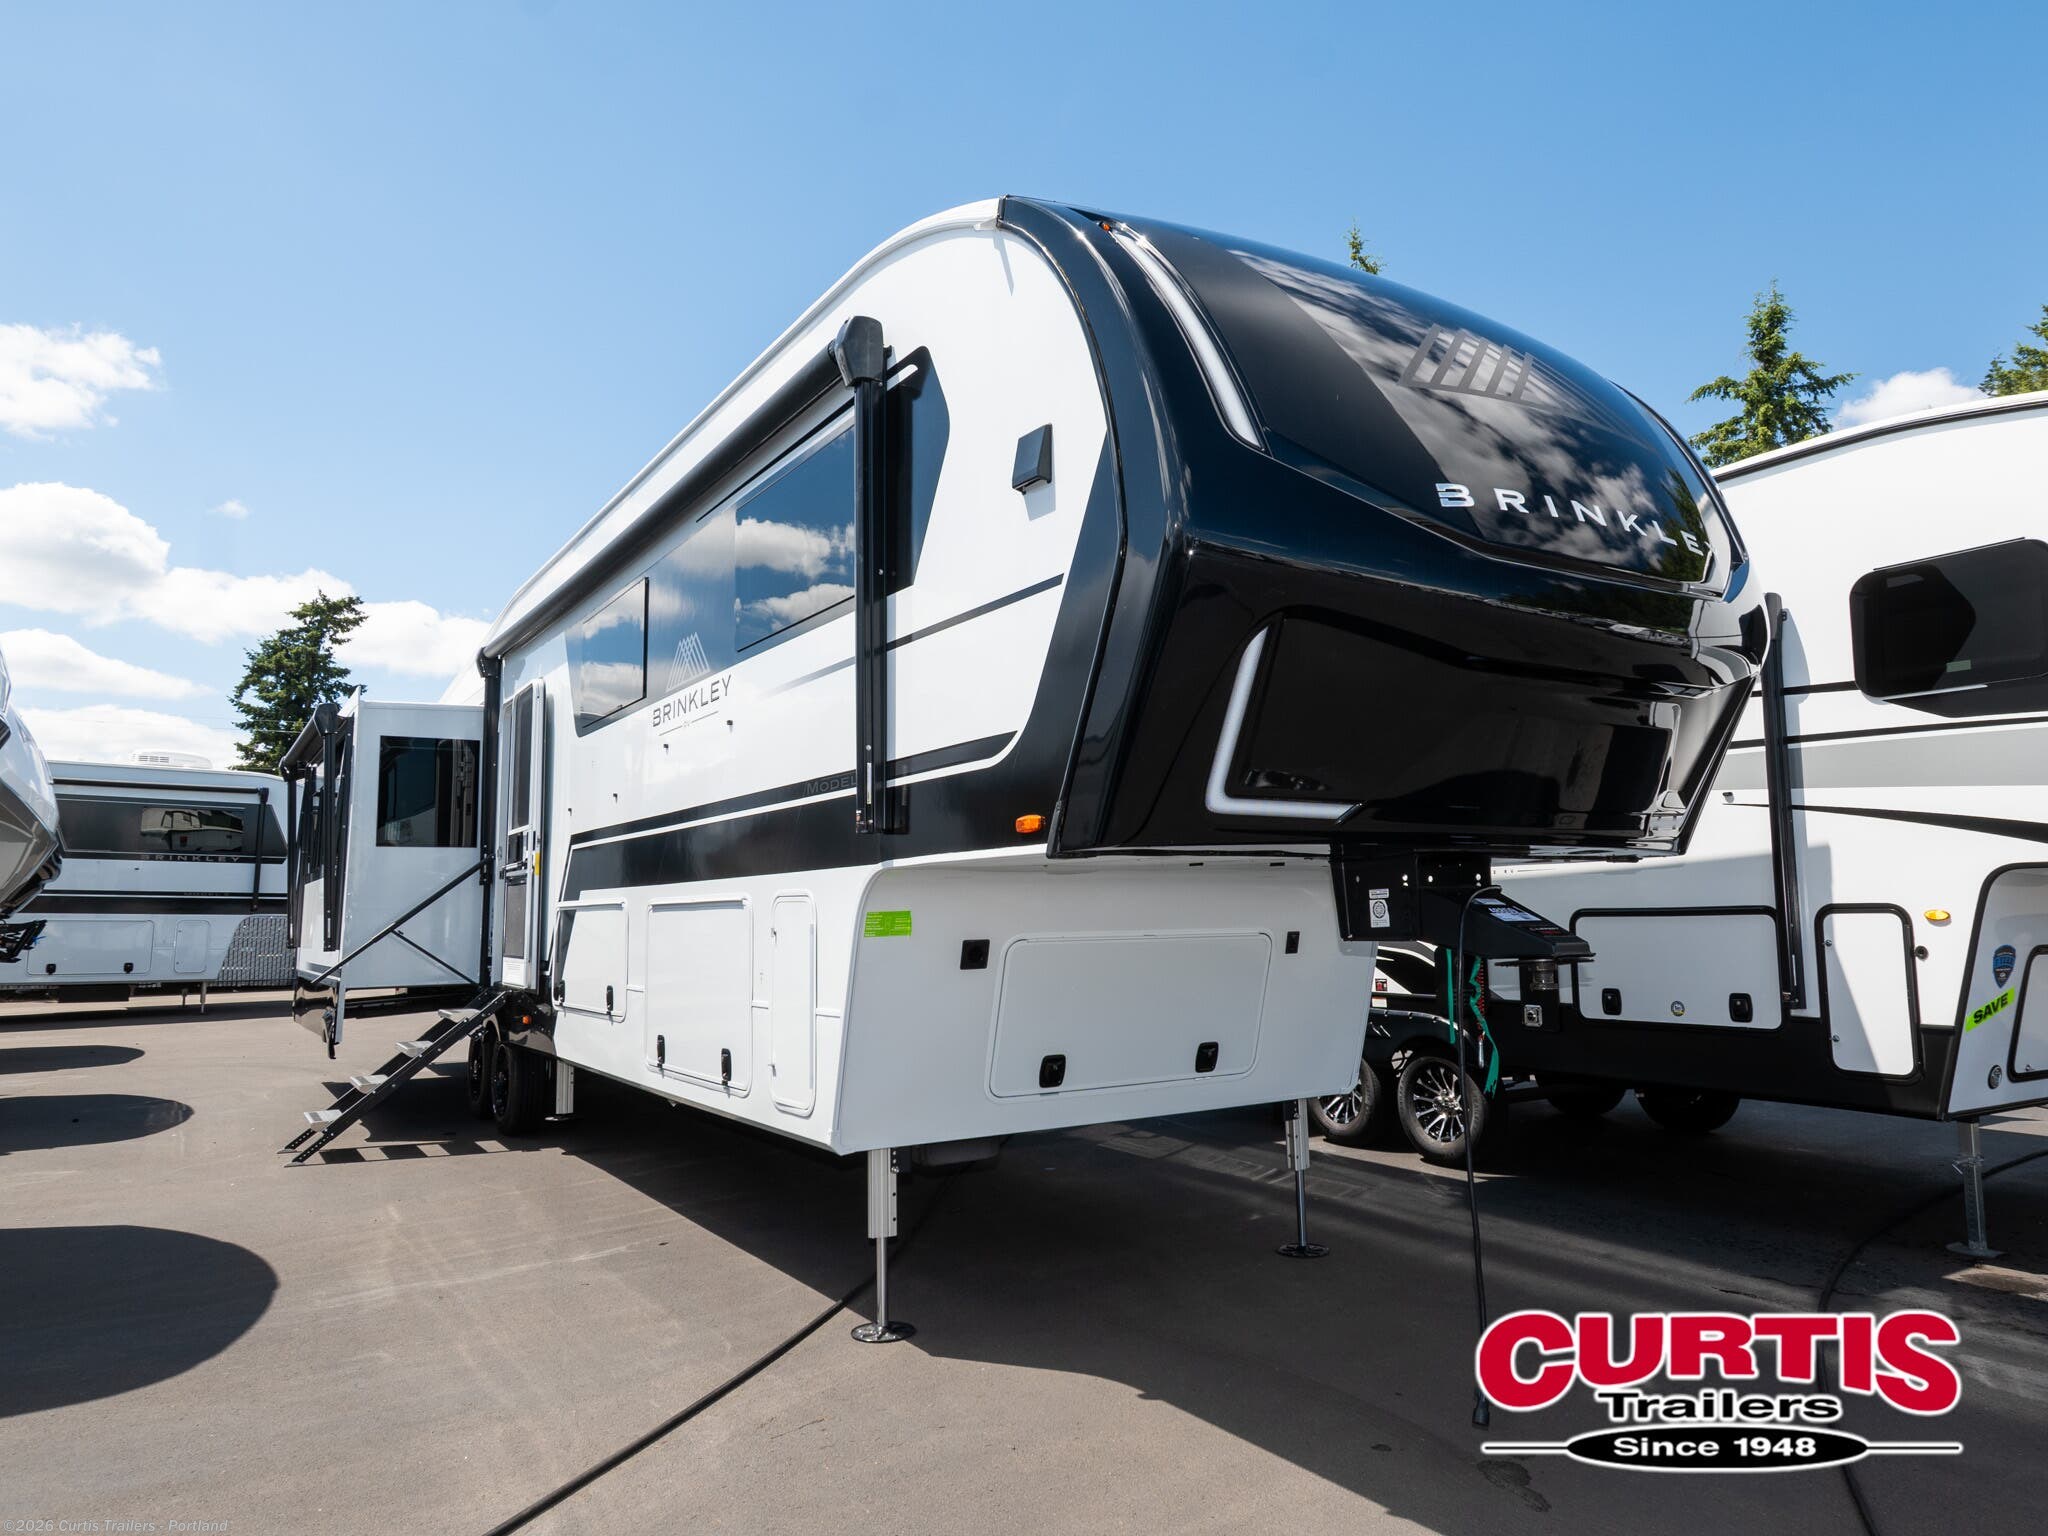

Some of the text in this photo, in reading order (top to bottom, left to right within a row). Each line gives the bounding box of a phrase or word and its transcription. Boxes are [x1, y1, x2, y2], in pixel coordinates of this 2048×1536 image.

[652, 674, 731, 727] BRINKLEY
[806, 774, 858, 795] MODEL
[1973, 992, 2009, 1025] SAVE
